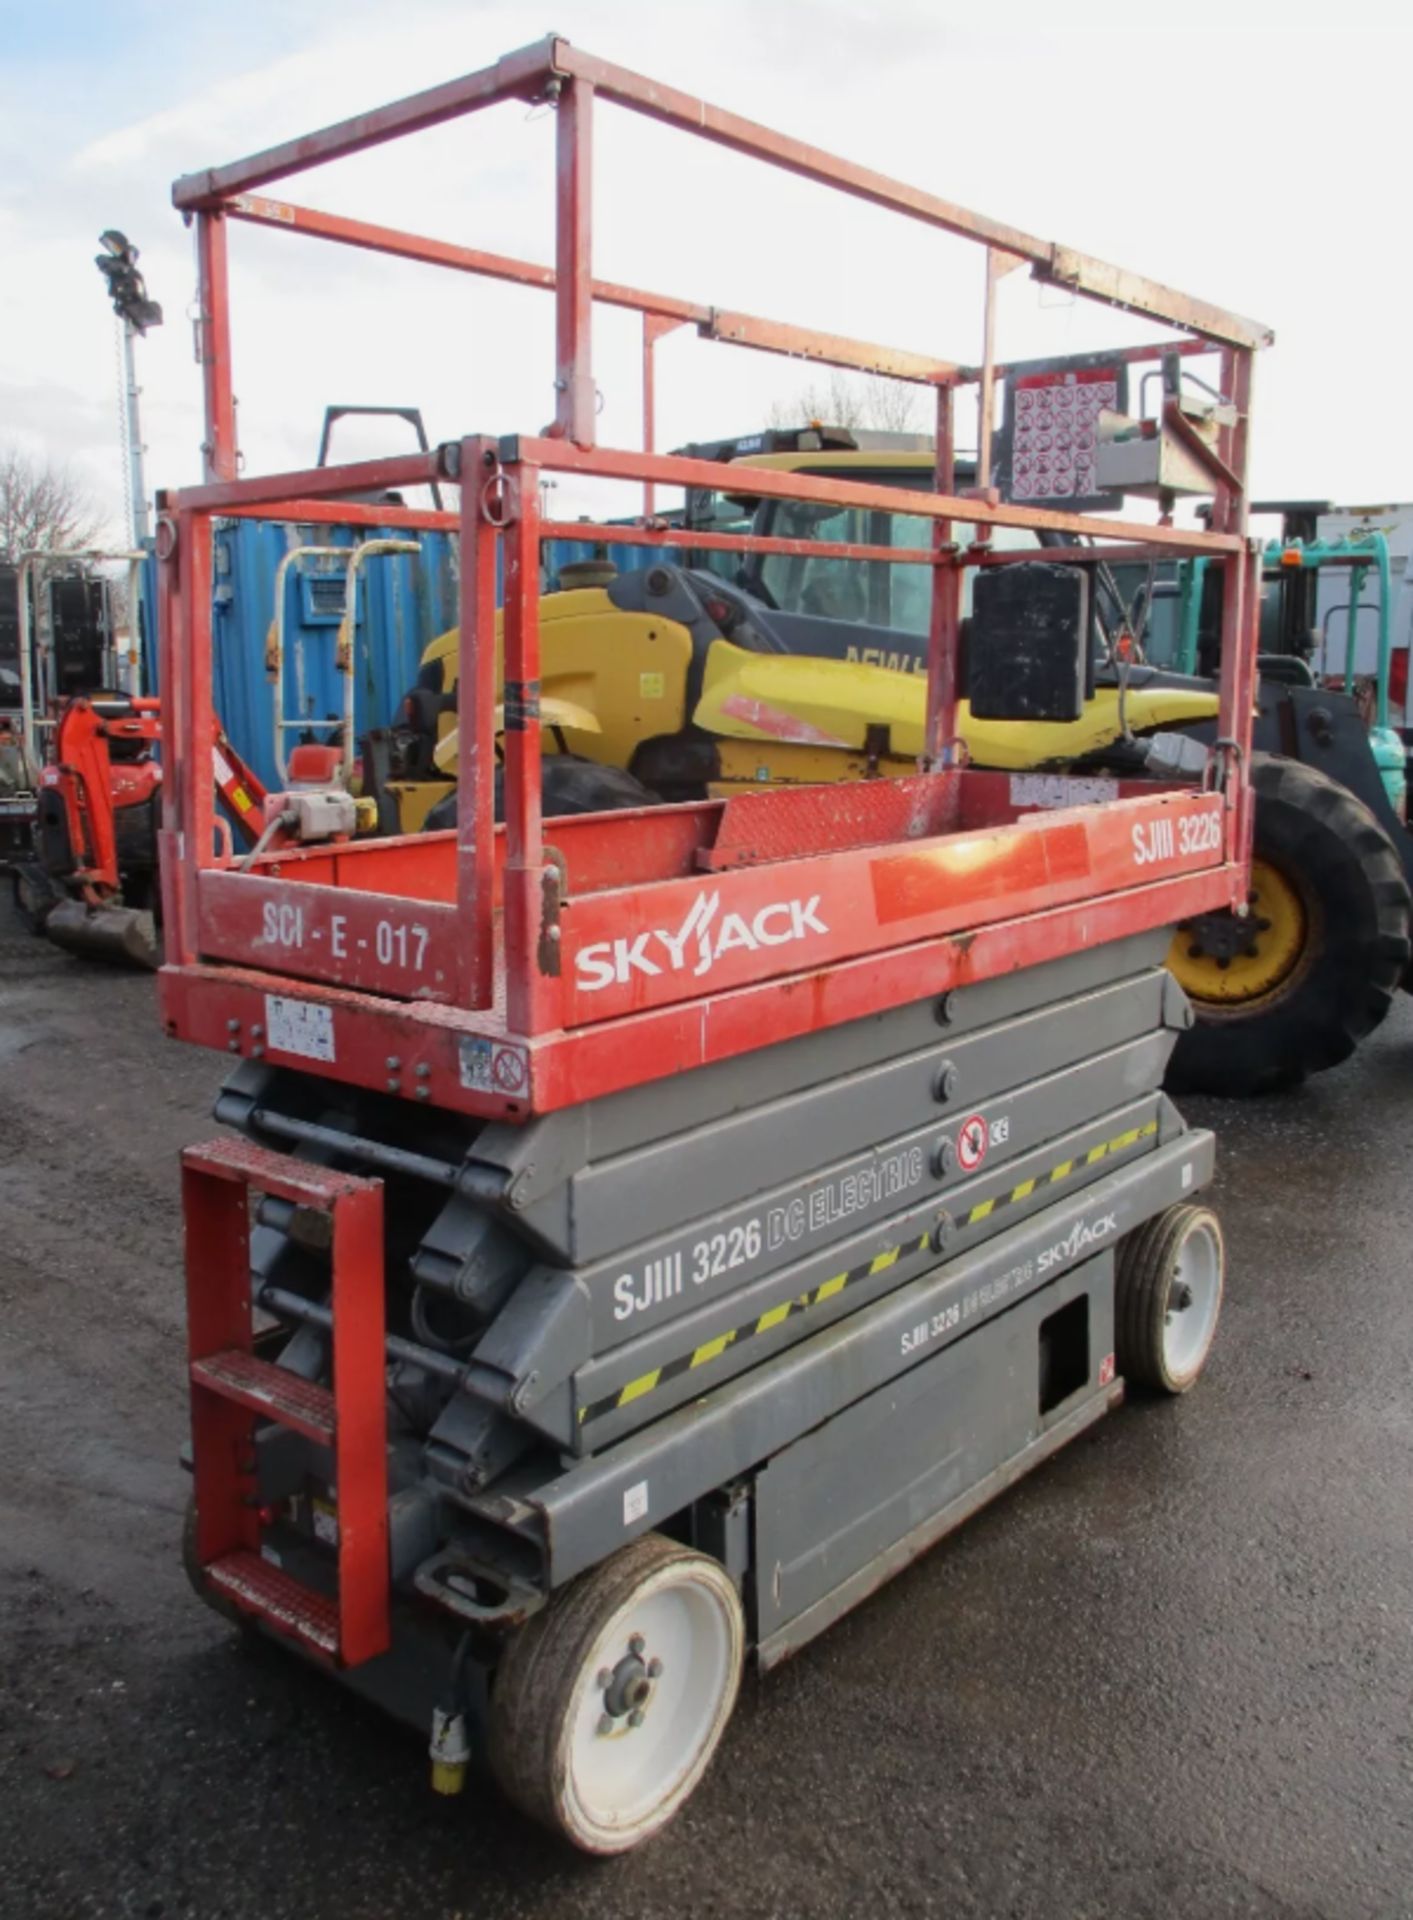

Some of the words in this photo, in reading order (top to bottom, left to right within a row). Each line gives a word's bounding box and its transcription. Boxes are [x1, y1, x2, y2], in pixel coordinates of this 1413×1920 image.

[1132, 822, 1174, 865] SJIII
[1178, 811, 1221, 856] 3226
[331, 915, 347, 958] E
[376, 919, 428, 970] 017
[574, 889, 829, 991] SKYJACK
[614, 1250, 682, 1320] SJIII
[692, 1218, 762, 1284] 3226
[767, 1198, 804, 1250] DC
[809, 1147, 924, 1231] ELECTRIC
[931, 1303, 960, 1337] 3226
[1036, 1212, 1118, 1273] SKYJACK
